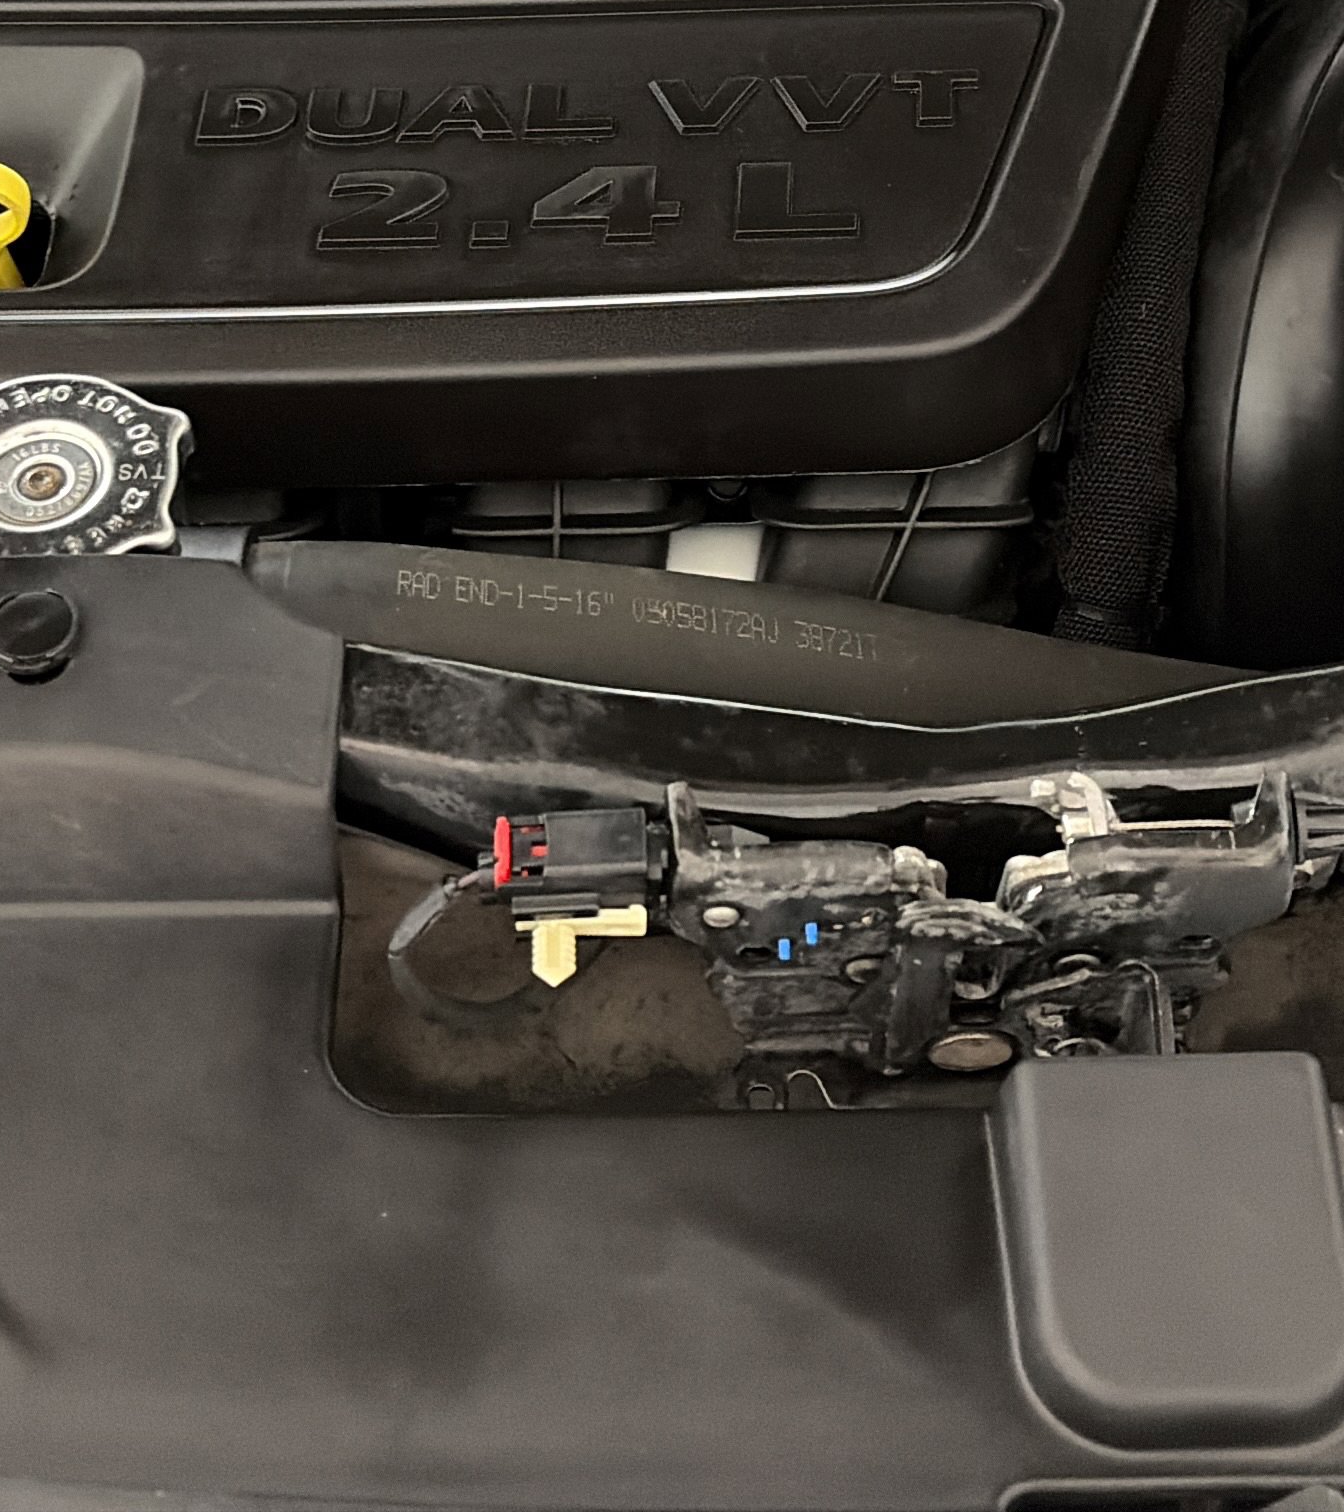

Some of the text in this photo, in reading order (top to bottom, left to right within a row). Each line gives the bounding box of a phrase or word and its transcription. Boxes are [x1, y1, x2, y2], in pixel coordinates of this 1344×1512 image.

[193, 68, 979, 148] DUAL VVT
[76, 389, 137, 425] NOT
[126, 423, 159, 456] DO
[118, 463, 165, 482] TVS
[396, 569, 441, 600] RAD
